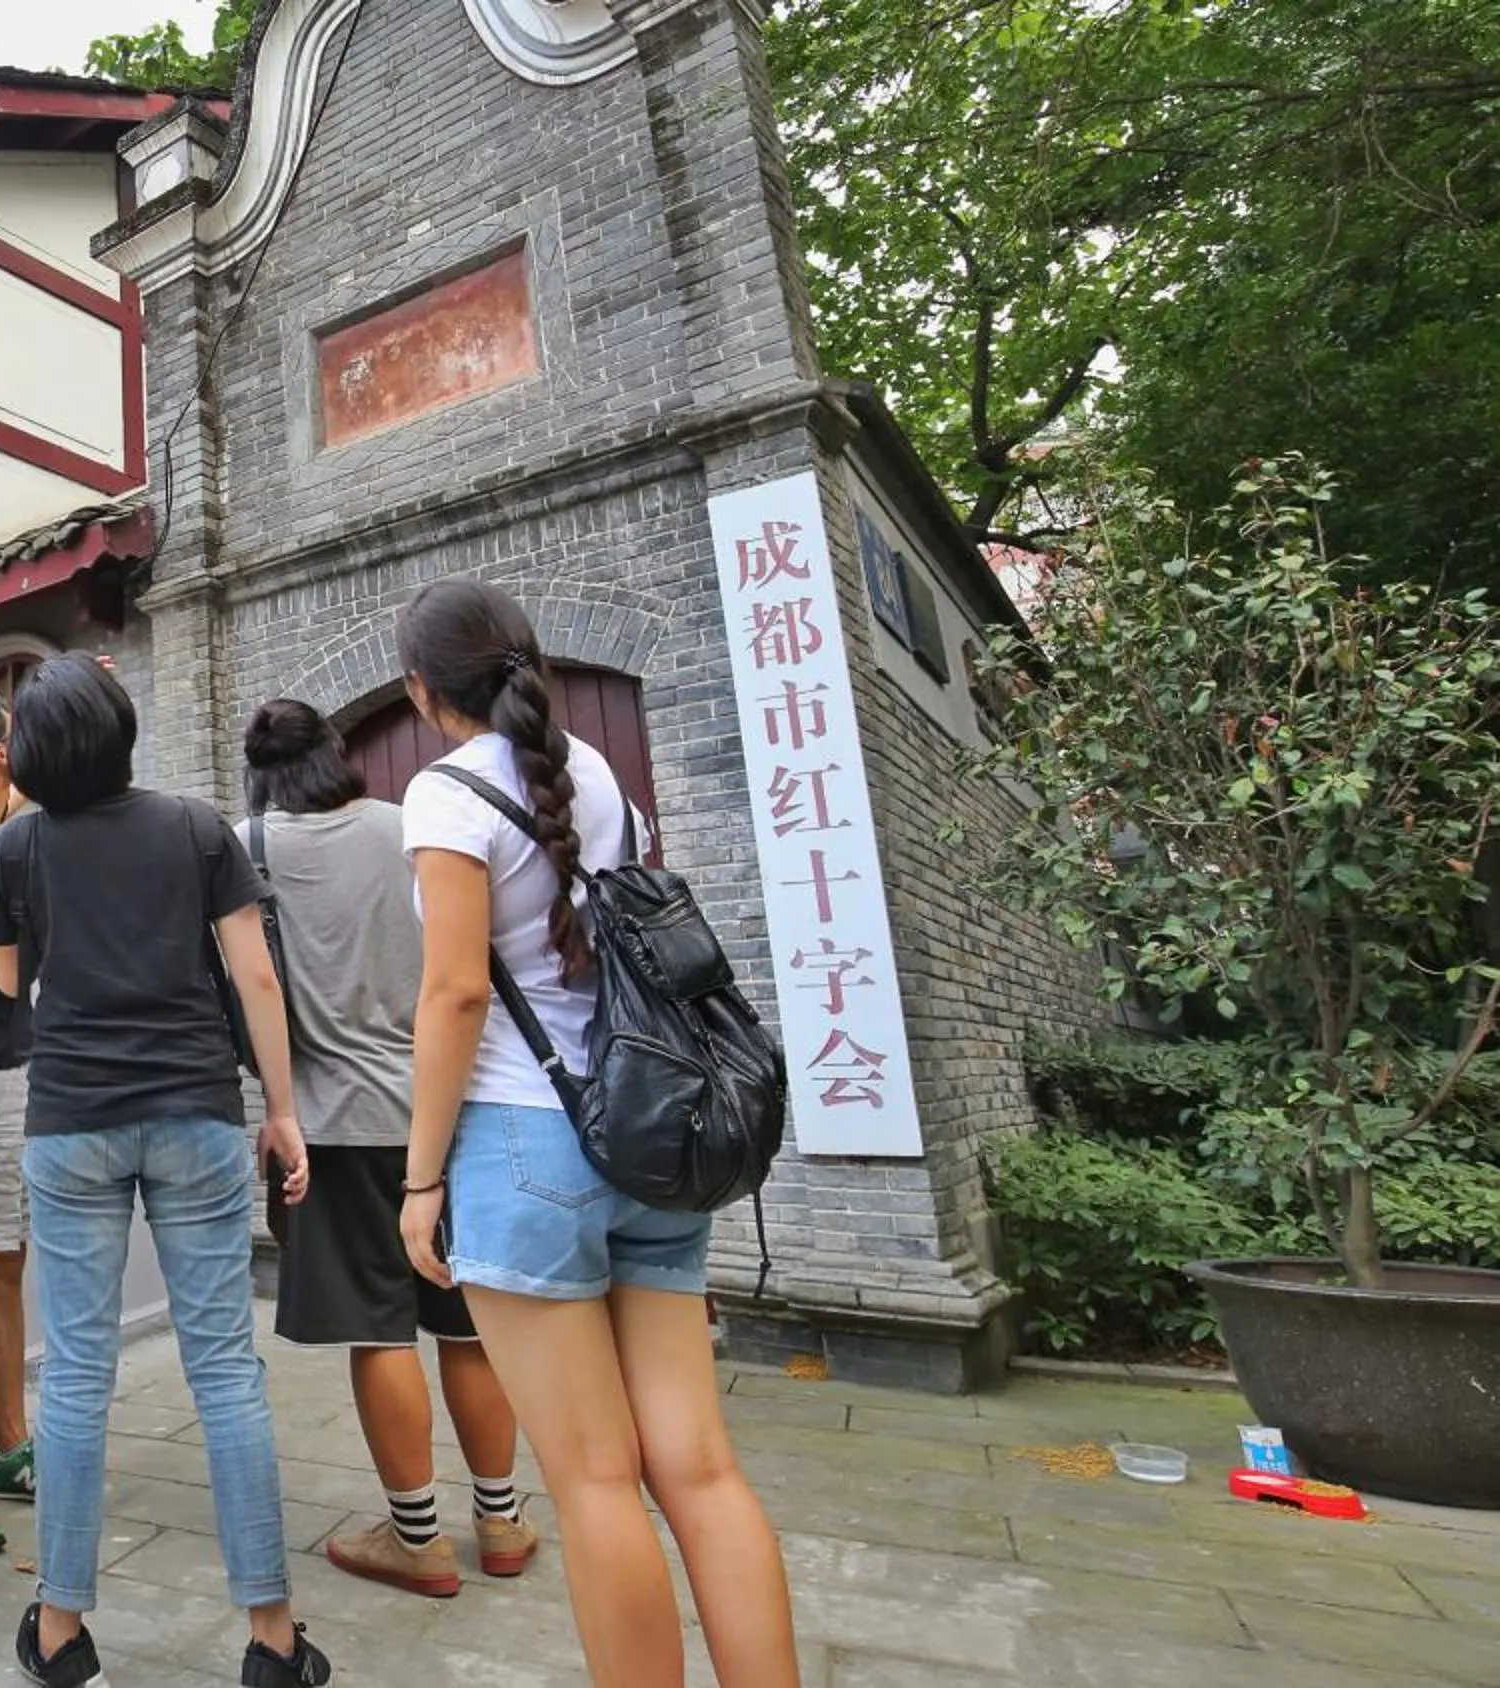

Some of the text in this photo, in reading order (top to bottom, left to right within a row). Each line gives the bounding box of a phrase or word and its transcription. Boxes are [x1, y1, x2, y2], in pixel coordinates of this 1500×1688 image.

[736, 521, 888, 1109] 成都市红十字会
